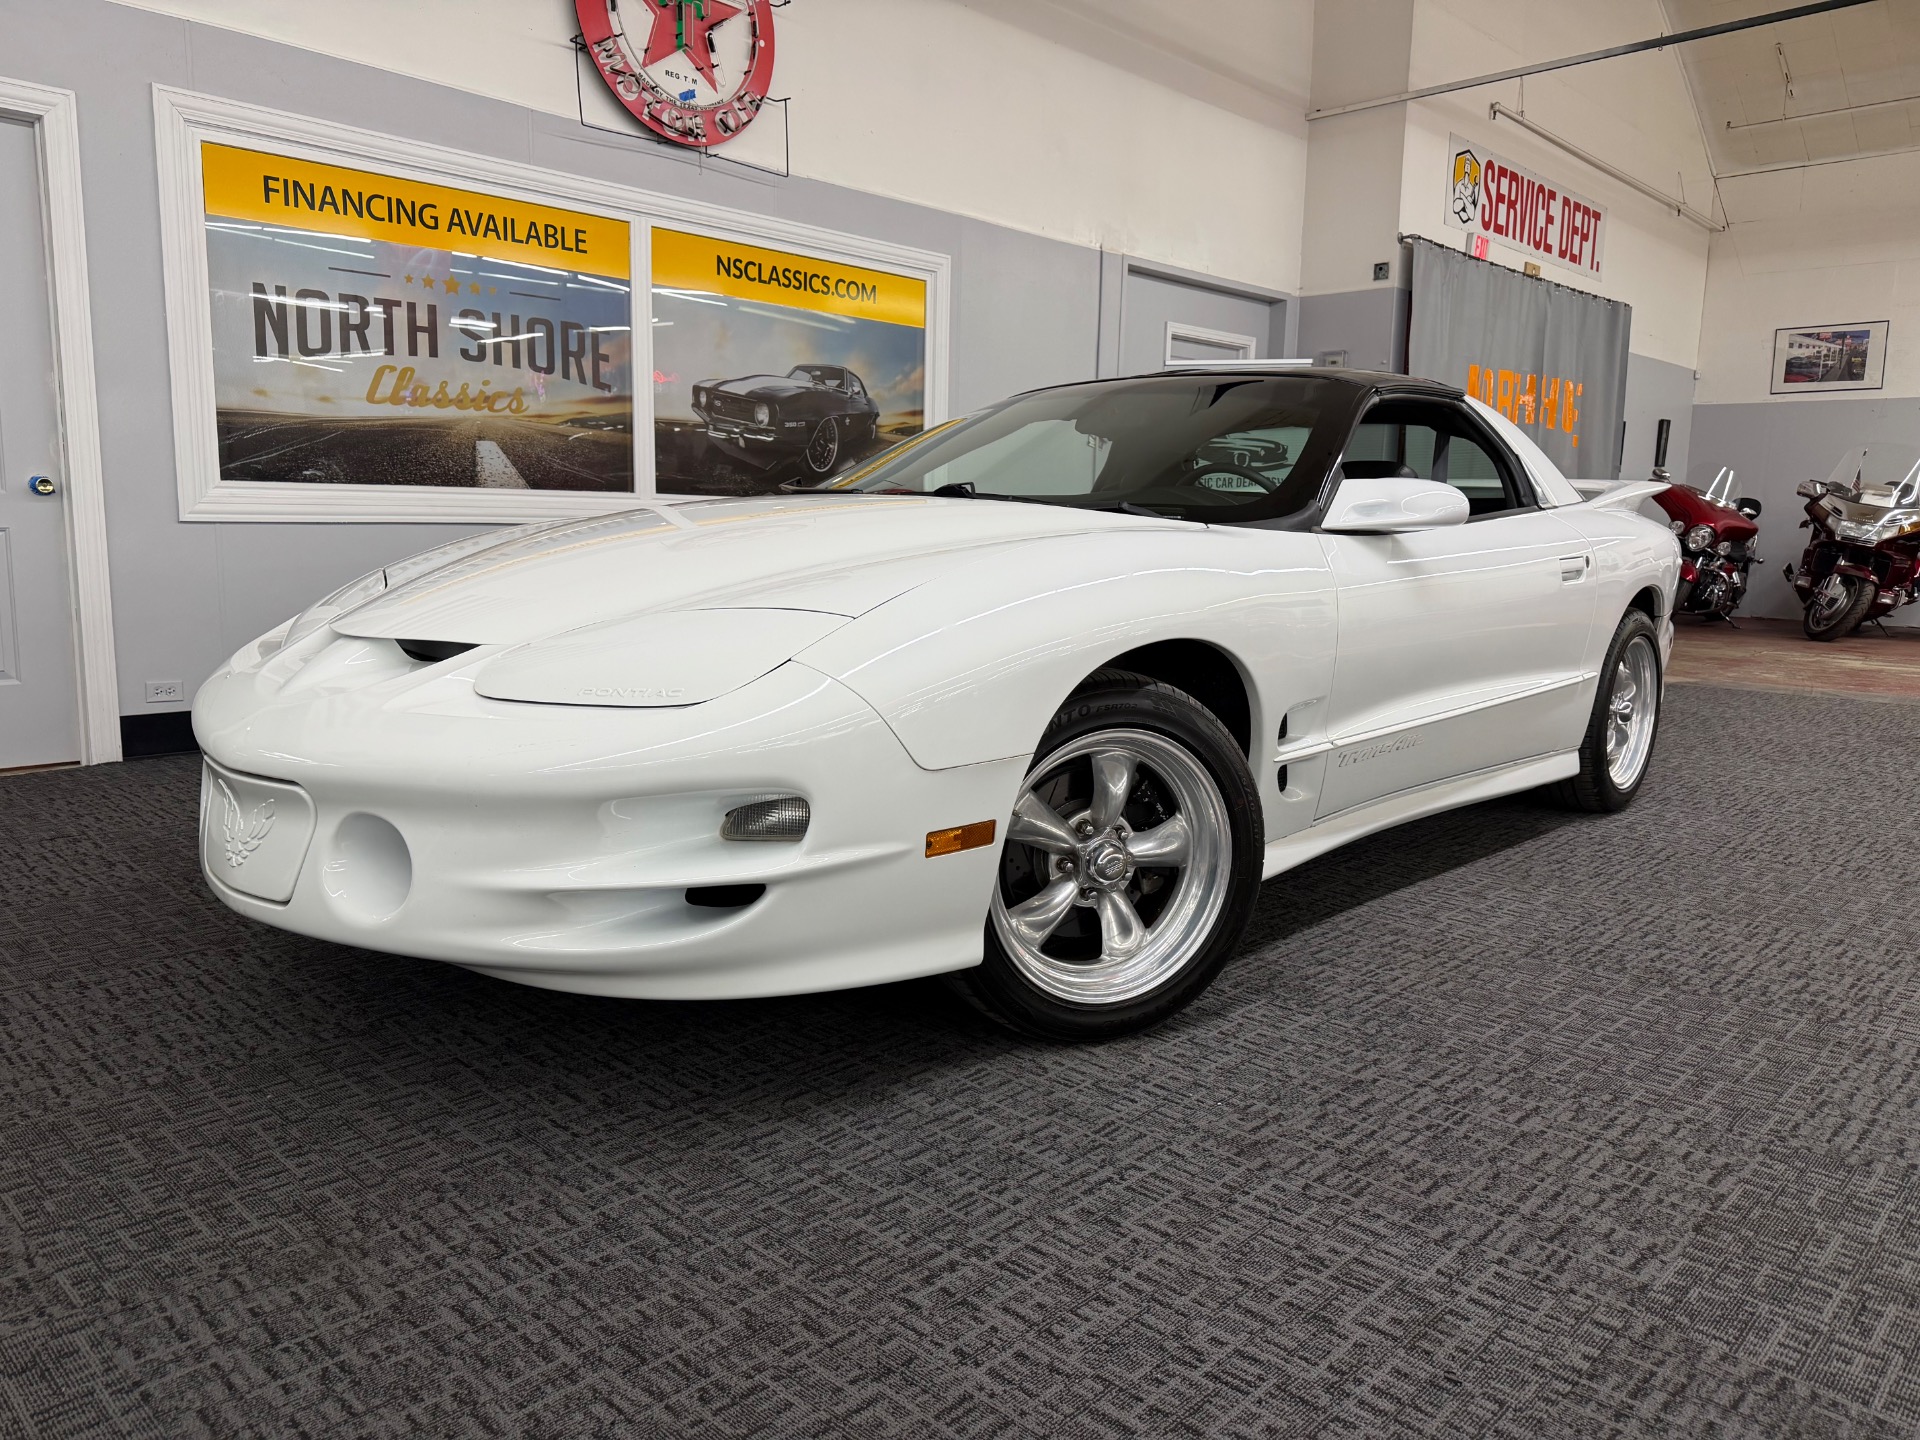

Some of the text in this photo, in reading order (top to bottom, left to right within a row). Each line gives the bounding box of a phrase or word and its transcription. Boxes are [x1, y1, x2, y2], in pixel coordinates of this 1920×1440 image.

[655, 88, 664, 98] BY
[666, 96, 677, 106] THE
[262, 174, 588, 254] FINANCING AVAILABLE
[1481, 159, 1601, 272] SERVICE DEPT.
[716, 255, 877, 304] NSCLASSICS.COM
[252, 281, 611, 393] NORTH SHORE
[365, 364, 530, 415] Classics
[1215, 477, 1232, 488] CAR
[577, 687, 685, 698] PONTIAC
